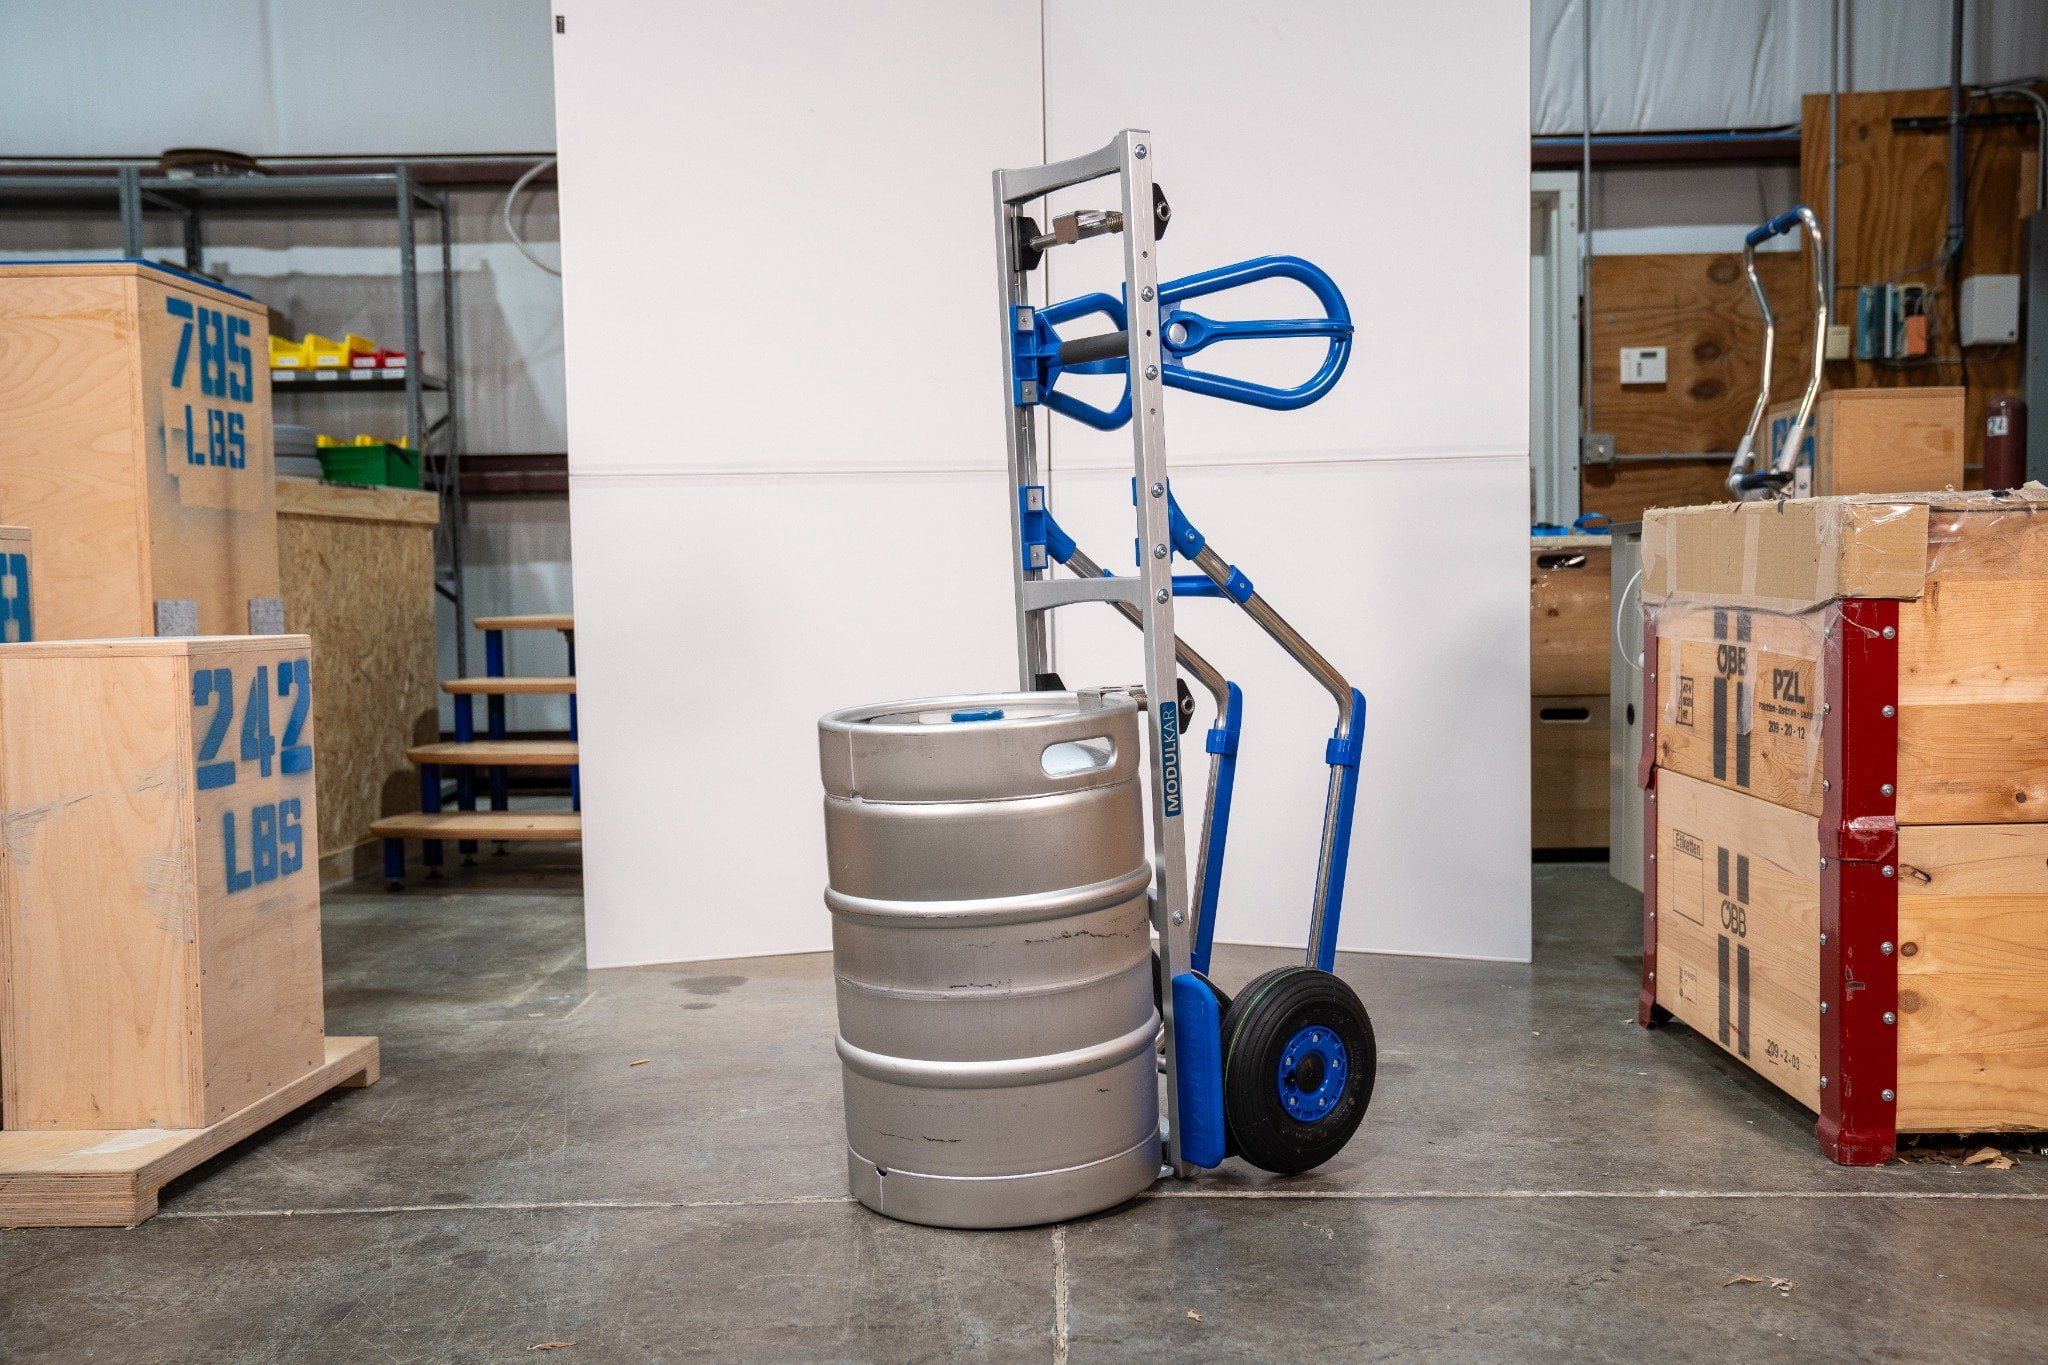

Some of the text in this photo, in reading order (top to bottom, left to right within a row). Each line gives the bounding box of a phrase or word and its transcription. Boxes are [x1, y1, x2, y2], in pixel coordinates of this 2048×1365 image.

[166, 296, 254, 403] 785
[185, 405, 245, 469] LBS
[193, 659, 314, 790] 242
[1773, 668, 1805, 704] PZL
[222, 797, 303, 895] LBS
[1675, 832, 1701, 857] Etiketten
